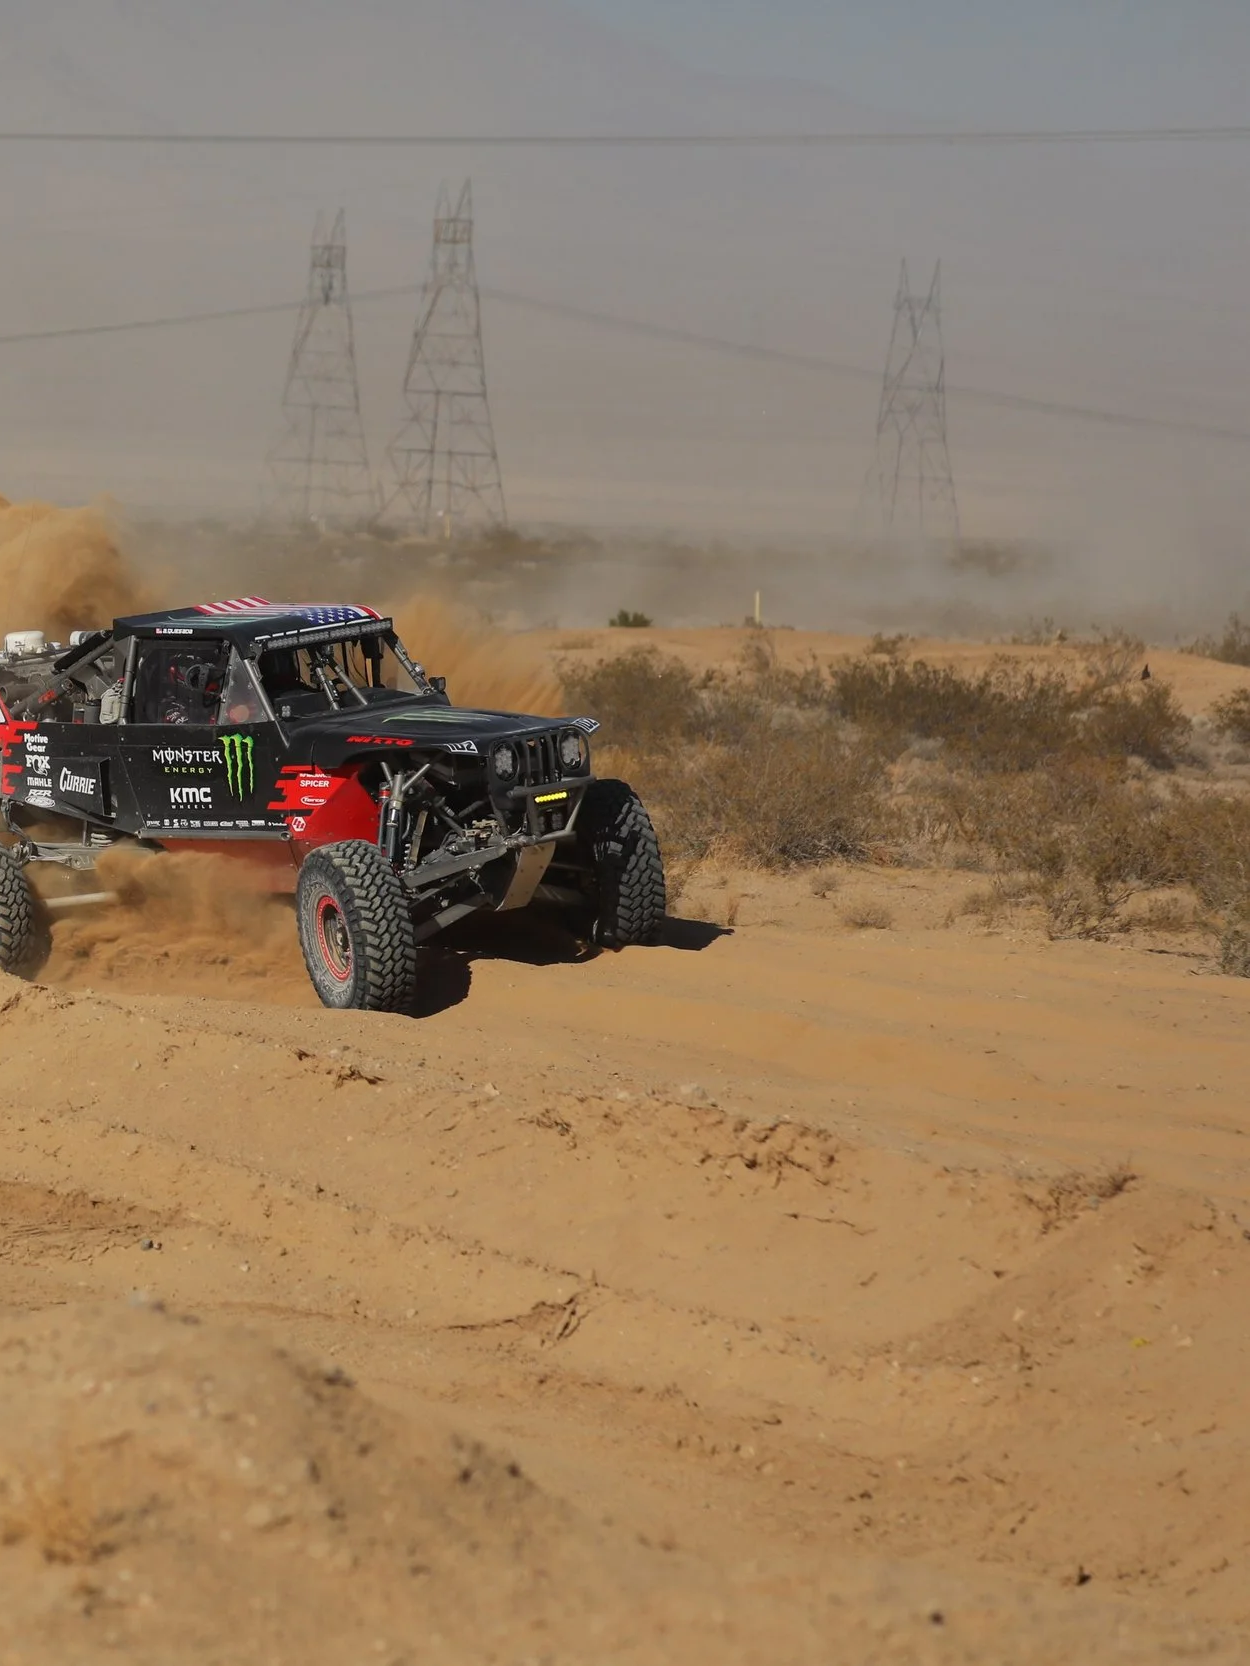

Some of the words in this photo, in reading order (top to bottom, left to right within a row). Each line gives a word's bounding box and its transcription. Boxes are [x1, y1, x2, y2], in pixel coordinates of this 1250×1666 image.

[24, 733, 48, 744] Motive
[347, 735, 413, 746] NITTO
[26, 743, 46, 752] Gear
[152, 747, 223, 764] MONSTER
[25, 755, 50, 773] FOX
[27, 777, 52, 787] MAHLE
[59, 766, 97, 795] CURRIE
[170, 787, 212, 803] KMC
